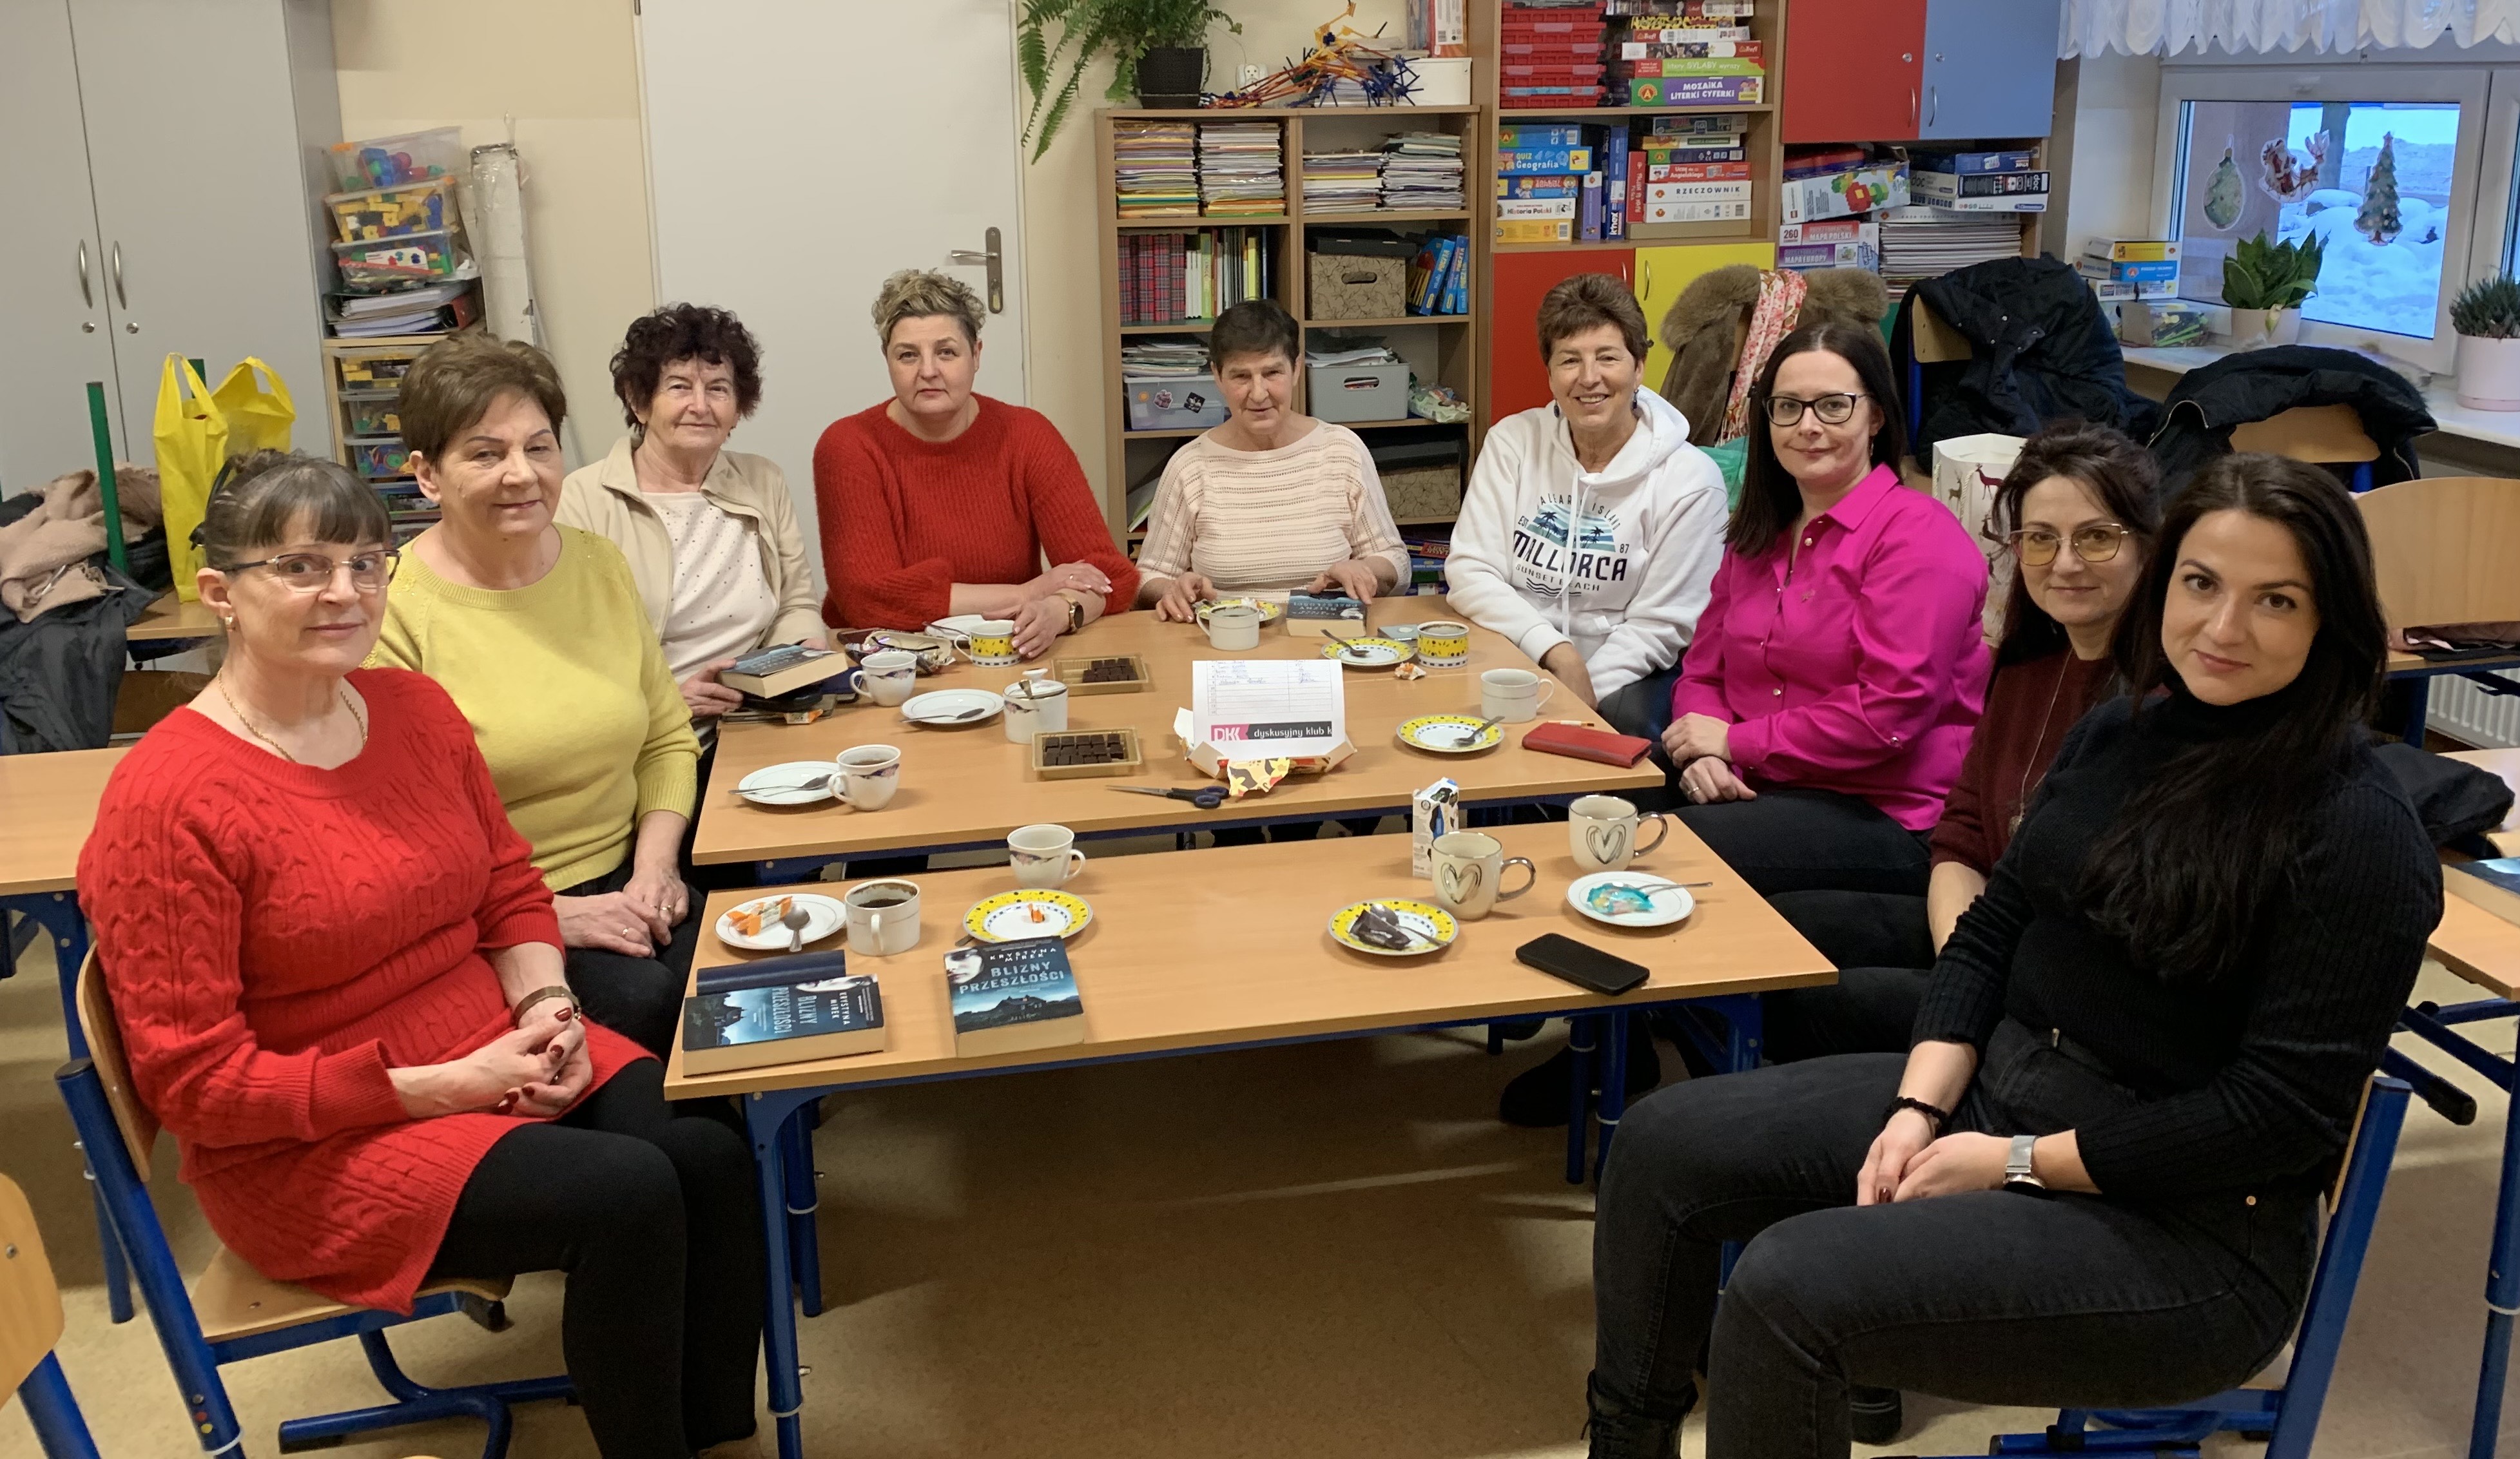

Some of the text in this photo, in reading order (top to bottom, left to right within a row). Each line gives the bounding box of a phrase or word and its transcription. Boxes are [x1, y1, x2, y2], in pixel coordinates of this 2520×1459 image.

[1516, 160, 1559, 171] Geografia
[1783, 229, 1799, 238] 260
[1810, 232, 1852, 241] MAPA POLSKI
[1785, 256, 1803, 264] MAPA
[1620, 543, 1630, 554] 87
[1515, 563, 1554, 583] SUNSET
[1254, 728, 1303, 739] dyskusyjny
[1305, 726, 1324, 736] klub
[990, 947, 1057, 961] KRYSTYNA
[1005, 952, 1044, 962] MIREK
[991, 961, 1051, 977] BLIZNY
[959, 970, 1064, 994] PRZESZŁOŚCI
[797, 995, 818, 1024] BLIZNY
[830, 999, 840, 1019] MIREK
[839, 992, 851, 1025] KRYSTYNA
